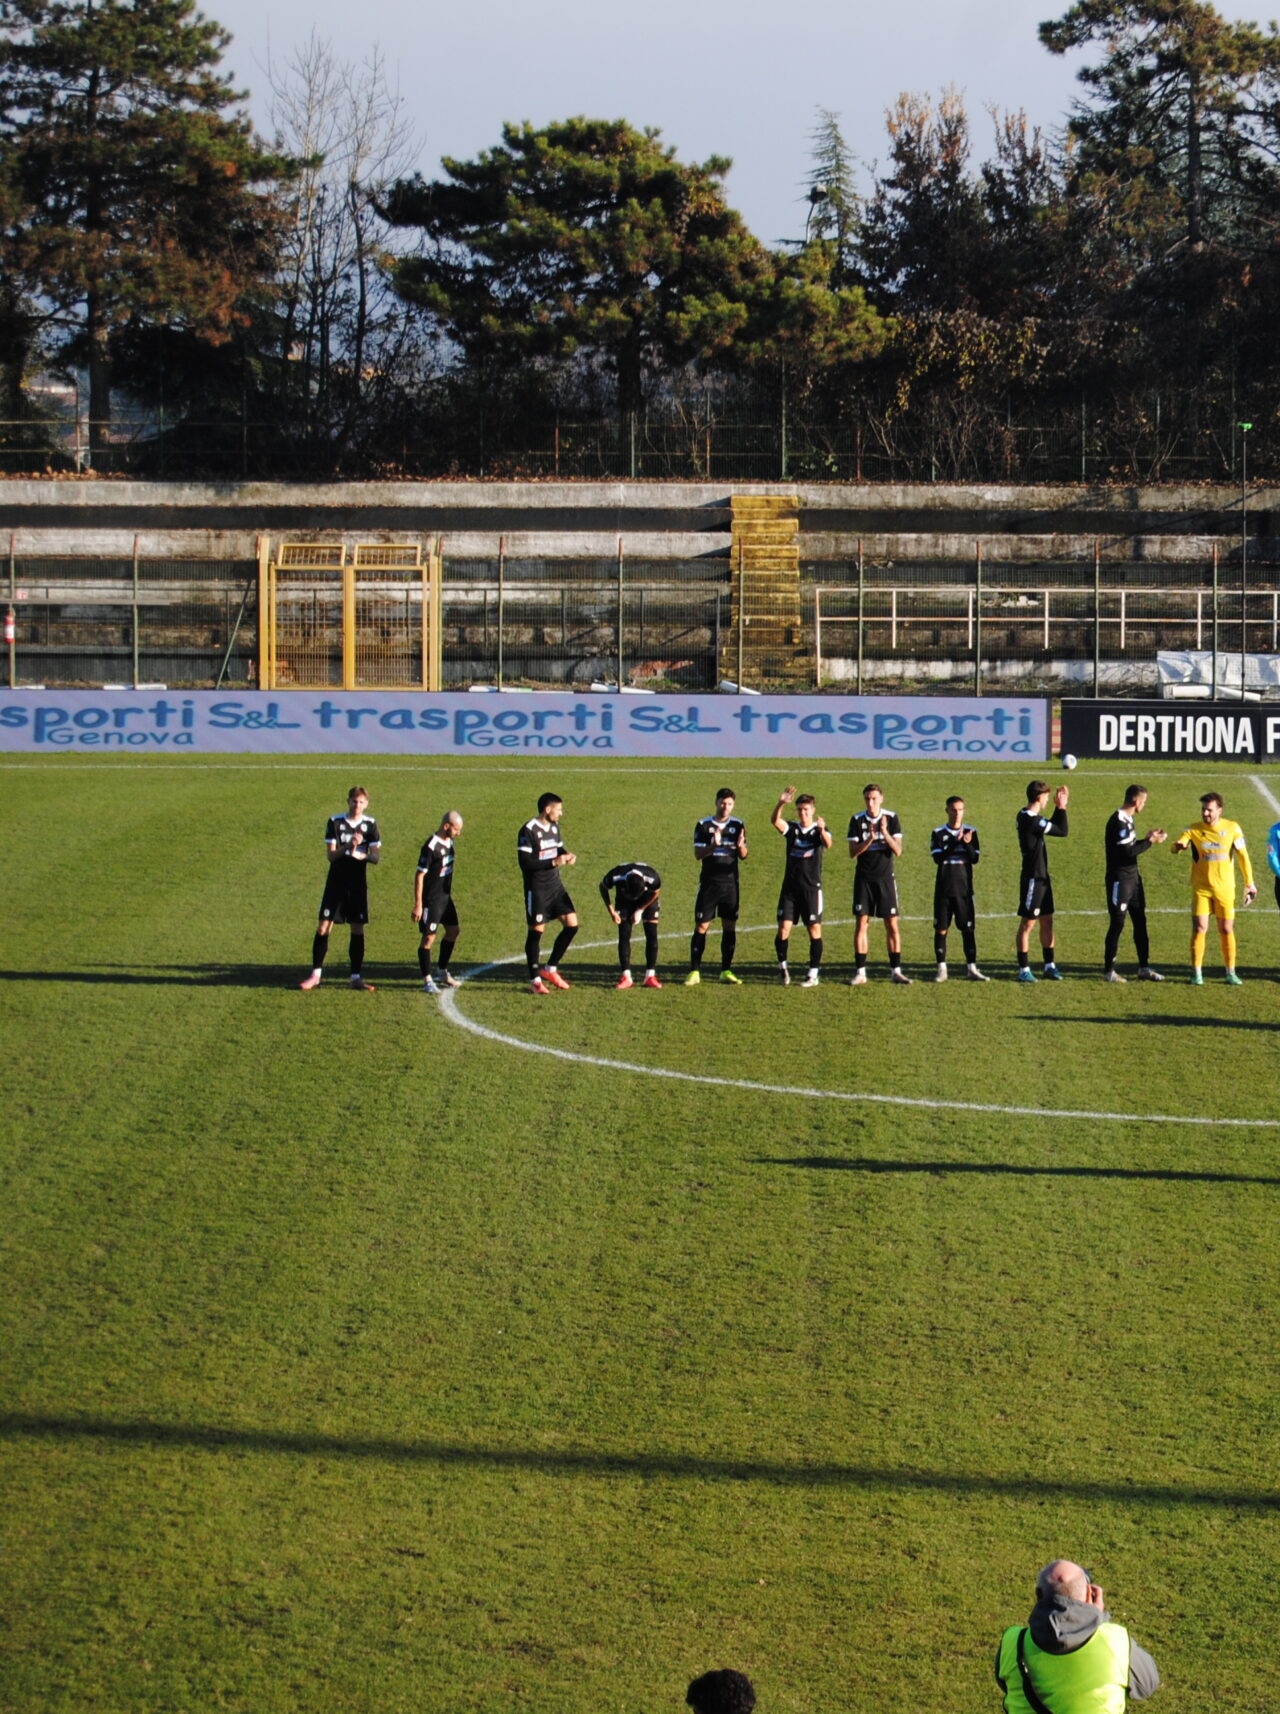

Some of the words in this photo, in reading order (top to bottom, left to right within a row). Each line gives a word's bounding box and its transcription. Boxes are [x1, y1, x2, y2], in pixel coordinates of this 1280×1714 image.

[47, 727, 194, 745] Genova
[208, 703, 301, 730] S&L
[319, 701, 613, 746] trasporti
[629, 705, 720, 733] S&L
[733, 705, 1031, 750] trasporti
[1100, 715, 1255, 753] DERTHONA
[468, 729, 614, 748] Genova
[886, 734, 1032, 753] Genova
